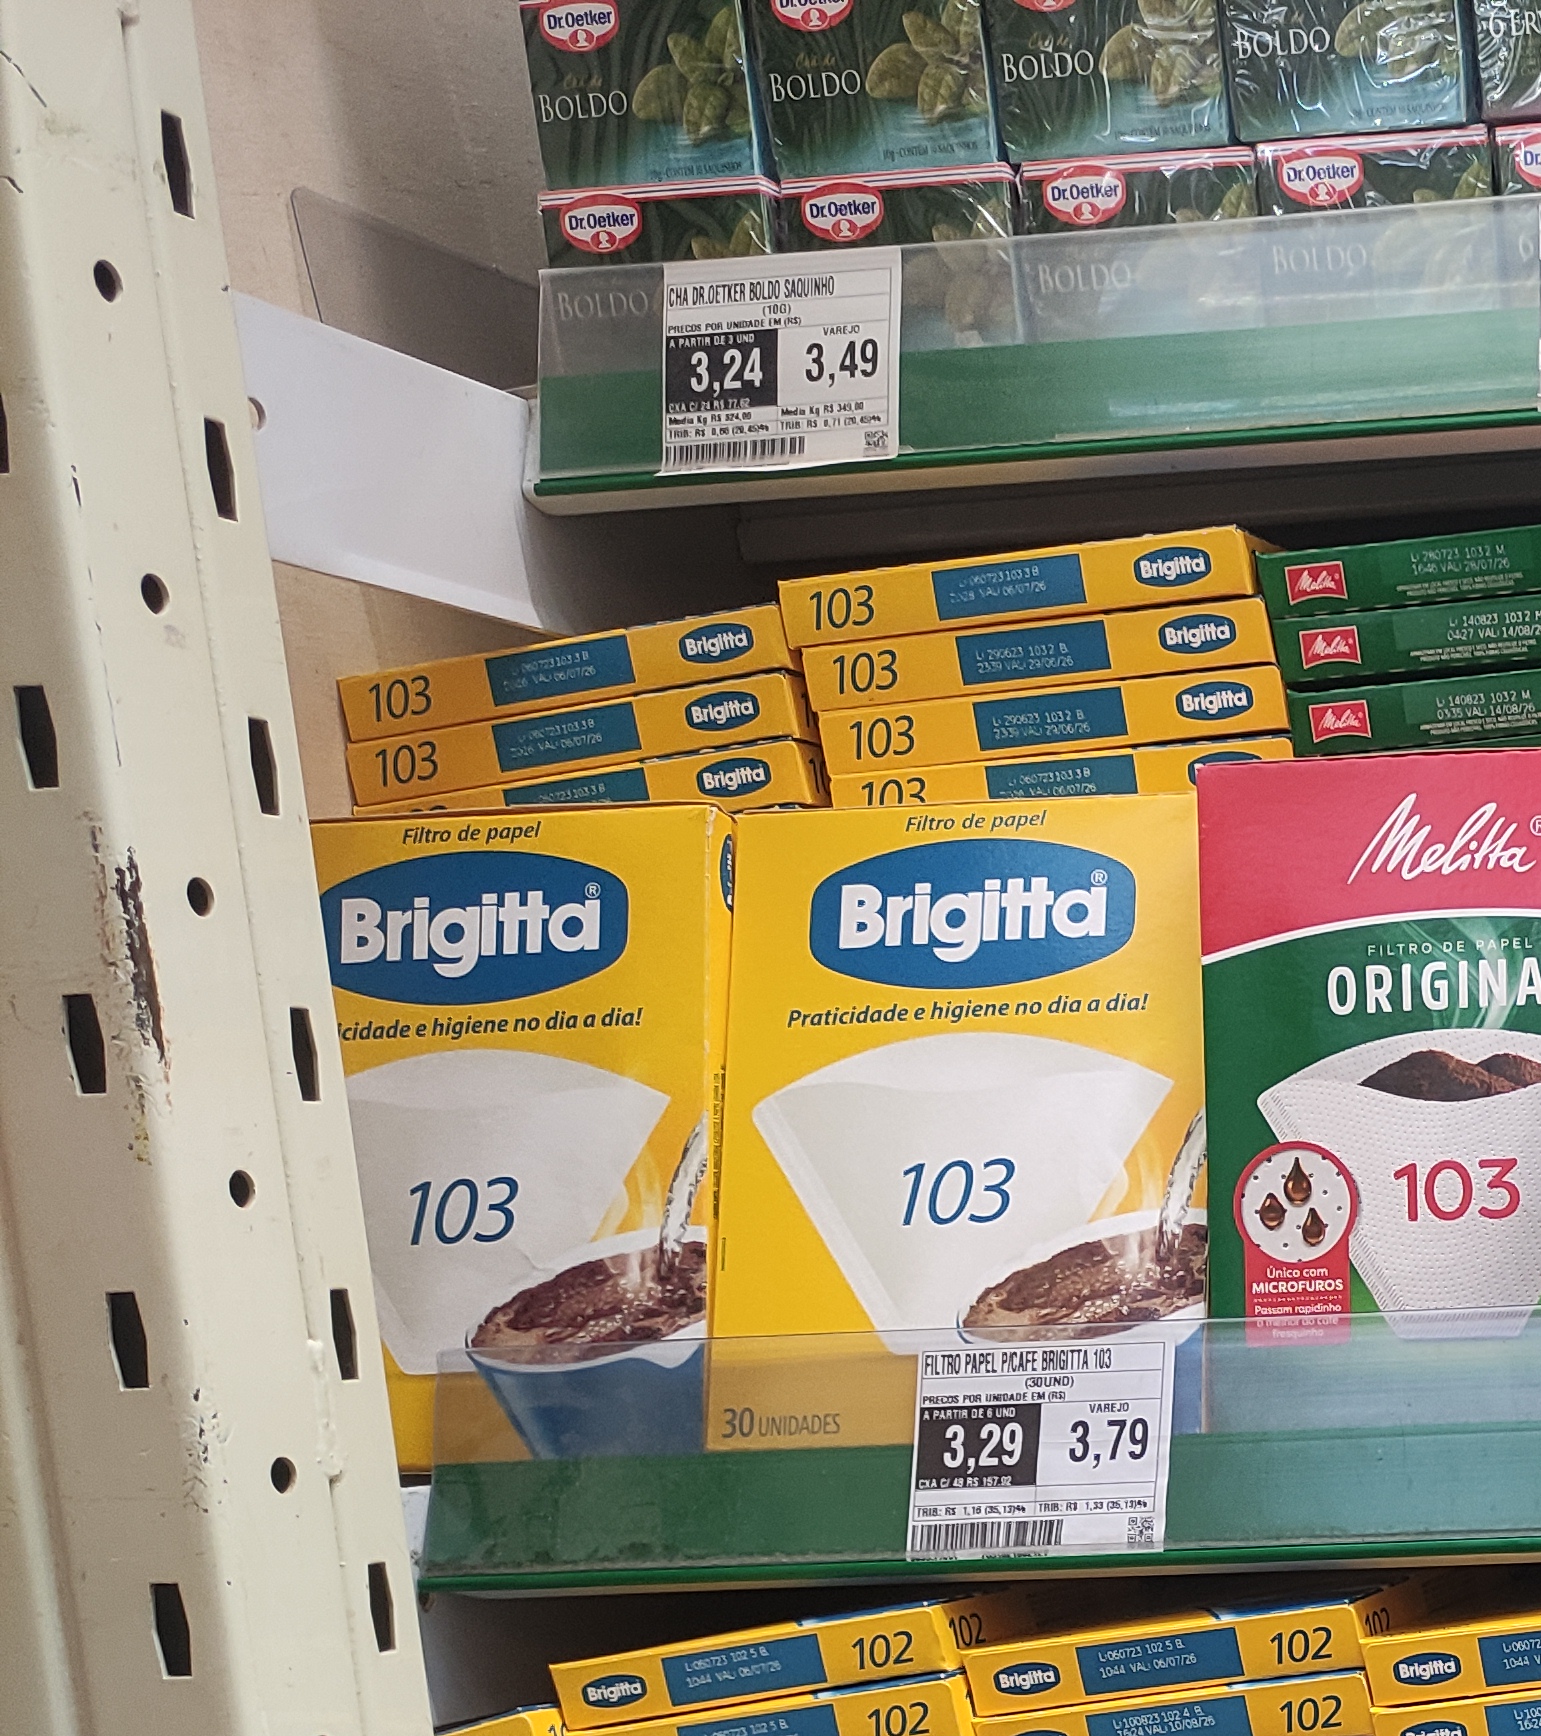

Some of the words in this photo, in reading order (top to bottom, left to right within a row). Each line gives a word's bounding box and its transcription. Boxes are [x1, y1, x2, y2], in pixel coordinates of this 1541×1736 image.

[538, 90, 628, 122] BOLDO
[669, 287, 688, 307] CHA
[692, 282, 745, 305] DR.OETKER
[749, 279, 780, 301] BOLDO
[784, 276, 835, 298] SAQUINHO
[762, 304, 791, 316] (10G)
[823, 325, 860, 336] VAREJO
[690, 347, 763, 397] 3,24
[805, 339, 878, 387] 3,49
[808, 585, 875, 631] 103
[684, 630, 749, 659] Brigitta
[904, 814, 954, 832] Filtro
[960, 813, 984, 831] de
[988, 808, 1047, 832] papel
[1347, 792, 1536, 885] Melitta
[339, 890, 602, 978] Brigitta
[837, 876, 1108, 963] Brigitta
[1366, 941, 1434, 957] FILTRO
[1442, 939, 1466, 954] DE
[1474, 936, 1533, 952] PAPEL
[788, 1004, 909, 1029] Praticidade
[914, 1010, 926, 1022] e
[930, 998, 1010, 1024] higiene
[1014, 1000, 1042, 1016] no
[1047, 994, 1081, 1014] dia
[1086, 999, 1100, 1013] a
[1105, 991, 1149, 1012] dia!
[902, 1158, 1017, 1228] 103
[1394, 1158, 1522, 1222] 103
[406, 1176, 520, 1246] 103
[1251, 1278, 1344, 1294] MICROFUROS
[1266, 1265, 1301, 1279] Único
[1302, 1268, 1329, 1278] com
[924, 1352, 960, 1376] FILTRO
[964, 1351, 997, 1374] PAPEL
[1001, 1350, 1037, 1373] P/CAFE
[1042, 1349, 1088, 1371] BRIGITTA
[1092, 1348, 1111, 1369] 103
[1024, 1376, 1074, 1389] (30UND)
[943, 1422, 1023, 1474] 3,29
[1069, 1418, 1148, 1469] 3,79
[851, 1632, 914, 1669] 102
